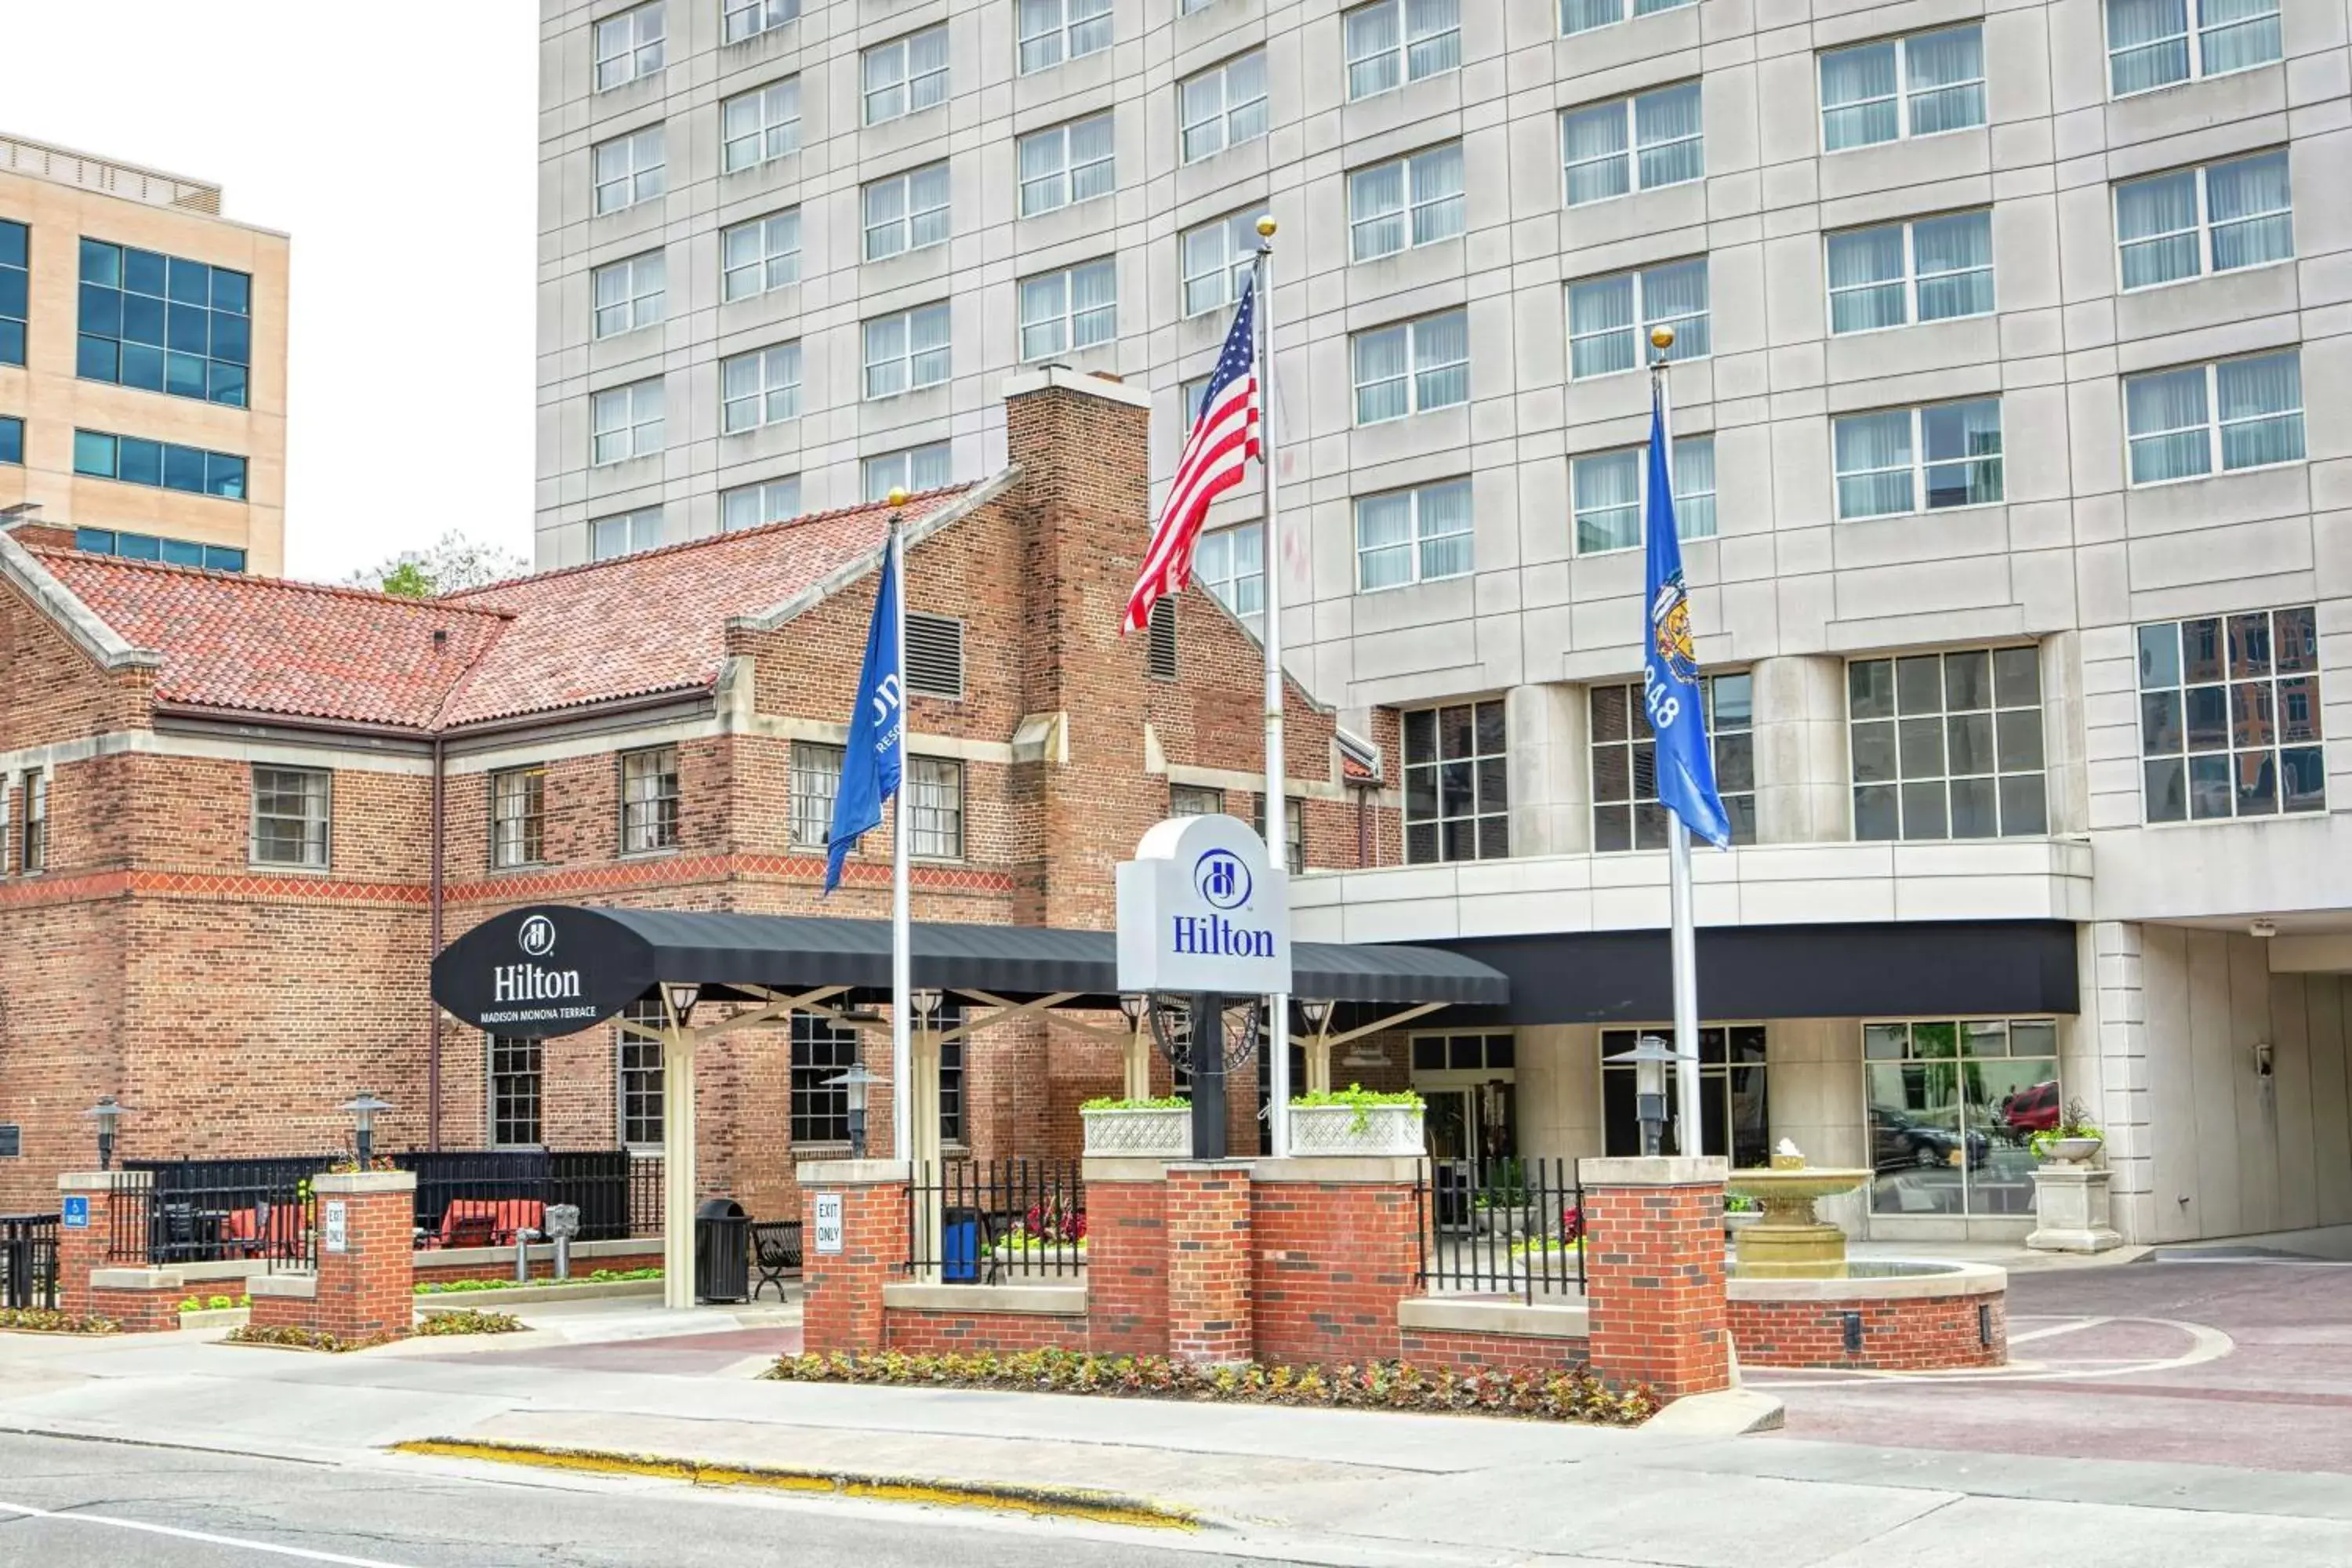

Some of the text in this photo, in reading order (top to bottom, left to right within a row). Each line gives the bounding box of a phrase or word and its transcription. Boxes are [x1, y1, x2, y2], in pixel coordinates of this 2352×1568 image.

[1173, 913, 1276, 957] Hilton
[494, 963, 581, 1003] Hilton
[481, 1005, 597, 1023] MADISON MONONA TERRACE
[328, 1210, 343, 1221] EXIT
[818, 1203, 838, 1218] EXIT
[818, 1227, 840, 1242] ONLY
